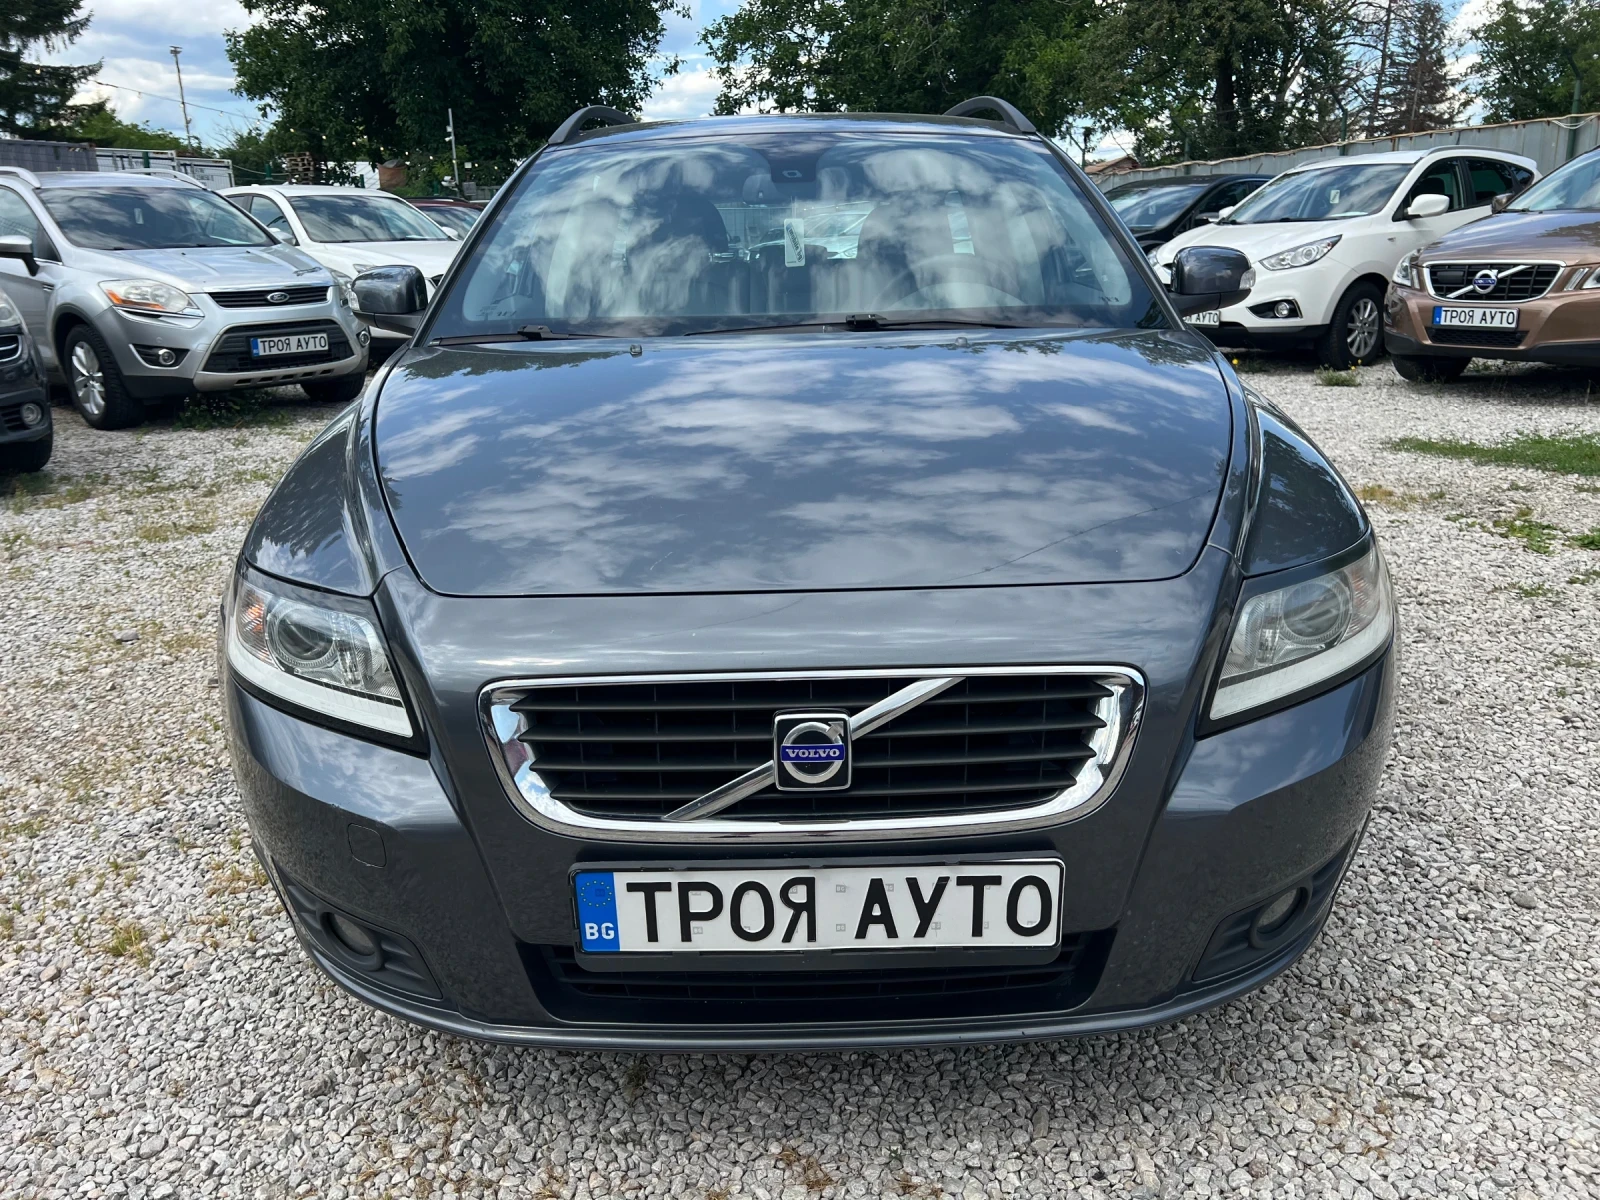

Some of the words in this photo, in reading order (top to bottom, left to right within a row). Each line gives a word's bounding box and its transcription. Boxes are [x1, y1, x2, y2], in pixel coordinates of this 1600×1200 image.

[1443, 309, 1474, 324] ТРОЯ
[1480, 310, 1515, 325] АУТО
[260, 338, 291, 353] ТРОЯ
[296, 336, 327, 350] АУТО
[785, 748, 840, 758] VOLVO
[626, 876, 817, 943] ТРОЯ
[854, 875, 1053, 940] АУТО
[584, 922, 615, 940] BG
